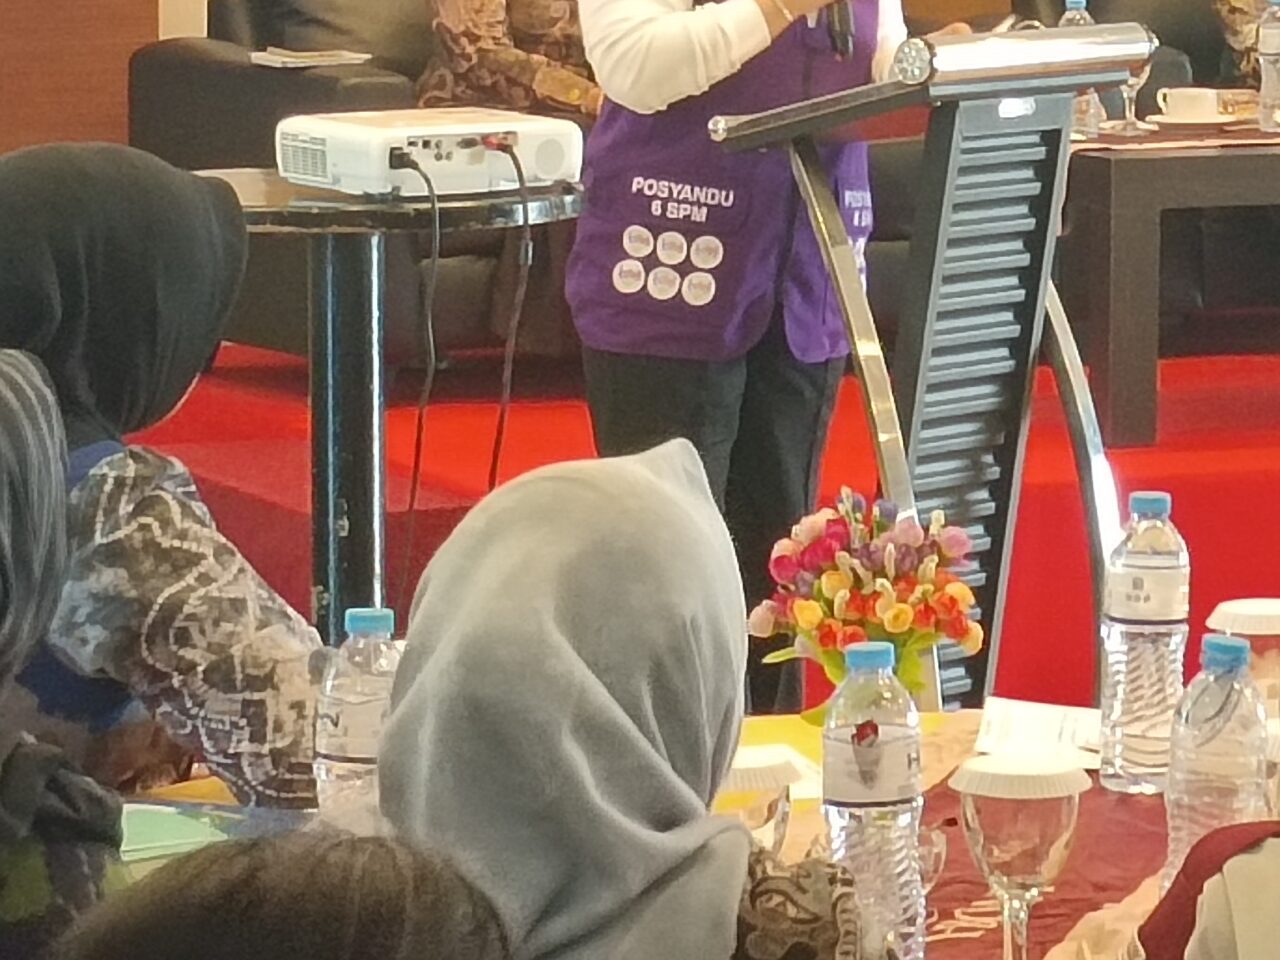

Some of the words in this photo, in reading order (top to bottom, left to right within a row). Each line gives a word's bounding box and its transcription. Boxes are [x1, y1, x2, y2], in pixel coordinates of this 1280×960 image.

[631, 176, 735, 208] POSYANDU
[650, 199, 662, 217] 6
[665, 200, 708, 223] SPM
